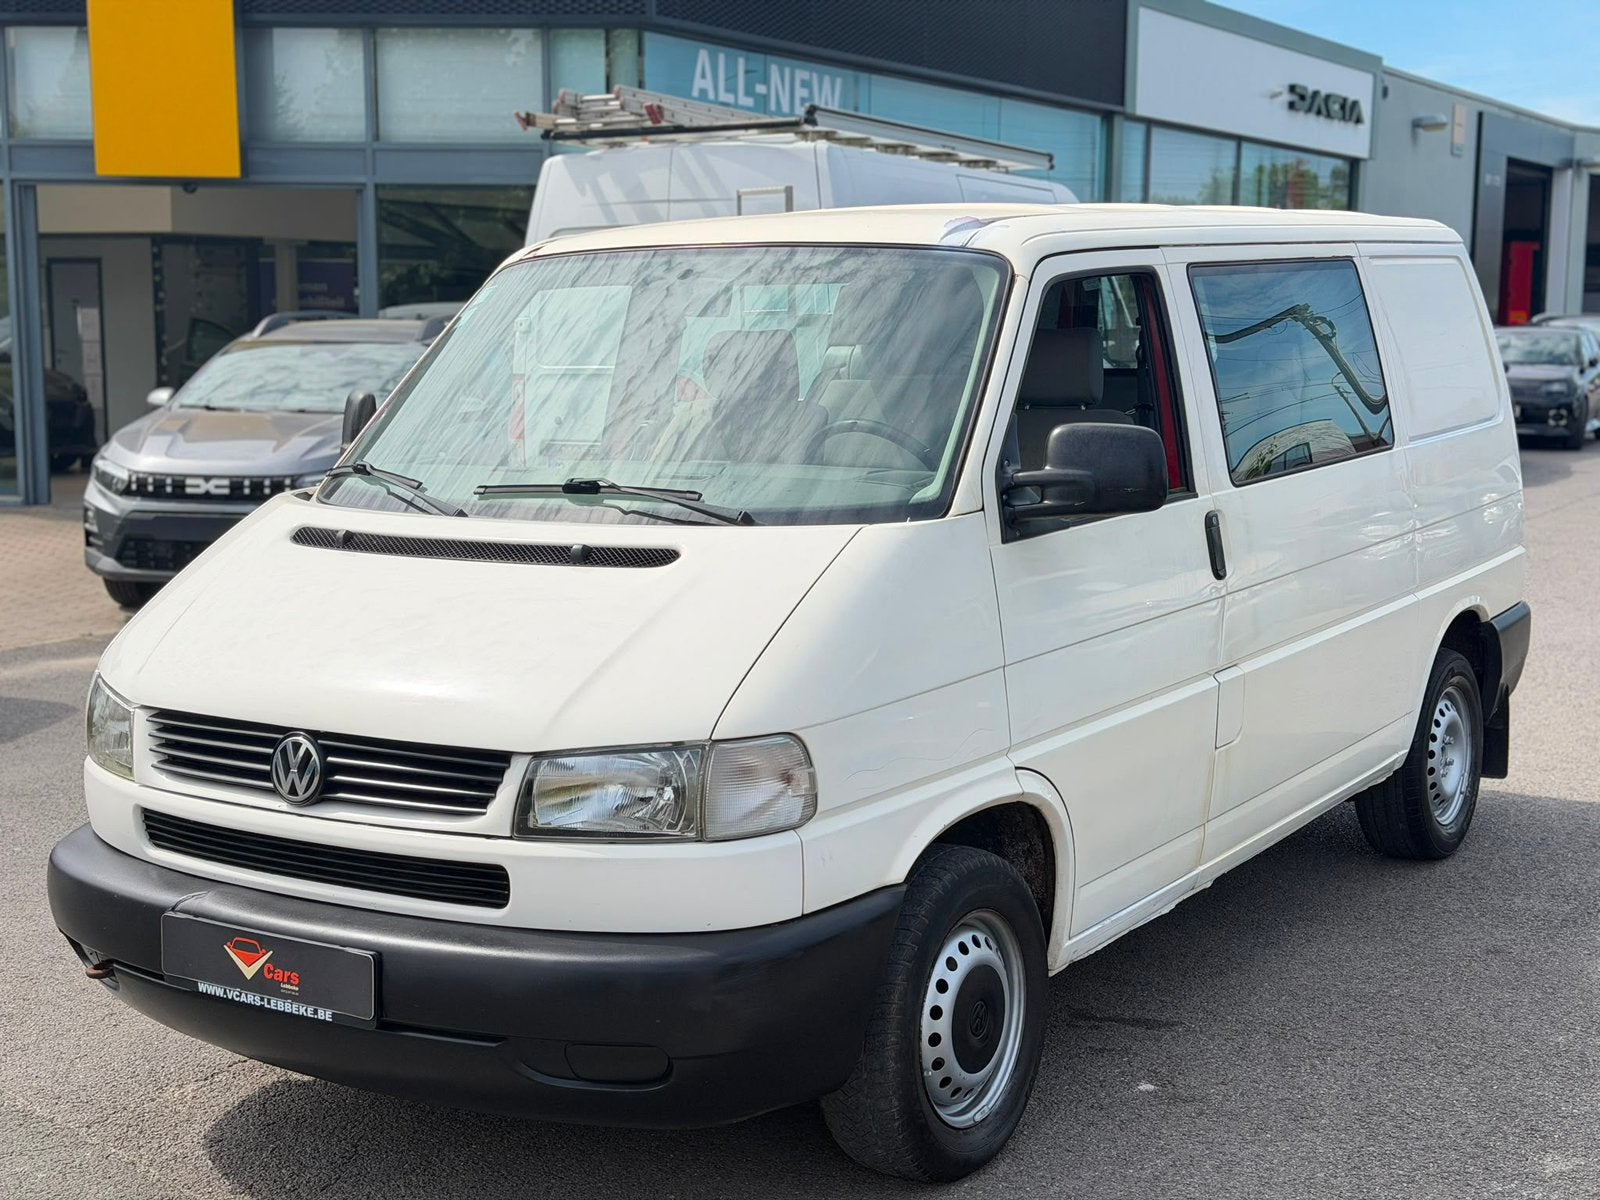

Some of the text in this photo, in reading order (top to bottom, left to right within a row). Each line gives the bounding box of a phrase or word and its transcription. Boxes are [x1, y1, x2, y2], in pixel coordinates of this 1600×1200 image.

[691, 49, 842, 116] ALL-NEW
[1288, 83, 1364, 125] DACIA
[272, 736, 320, 801] VW
[263, 963, 300, 985] Cars
[198, 982, 333, 1021] WWW.VCARS-LEBBEKE.BE
